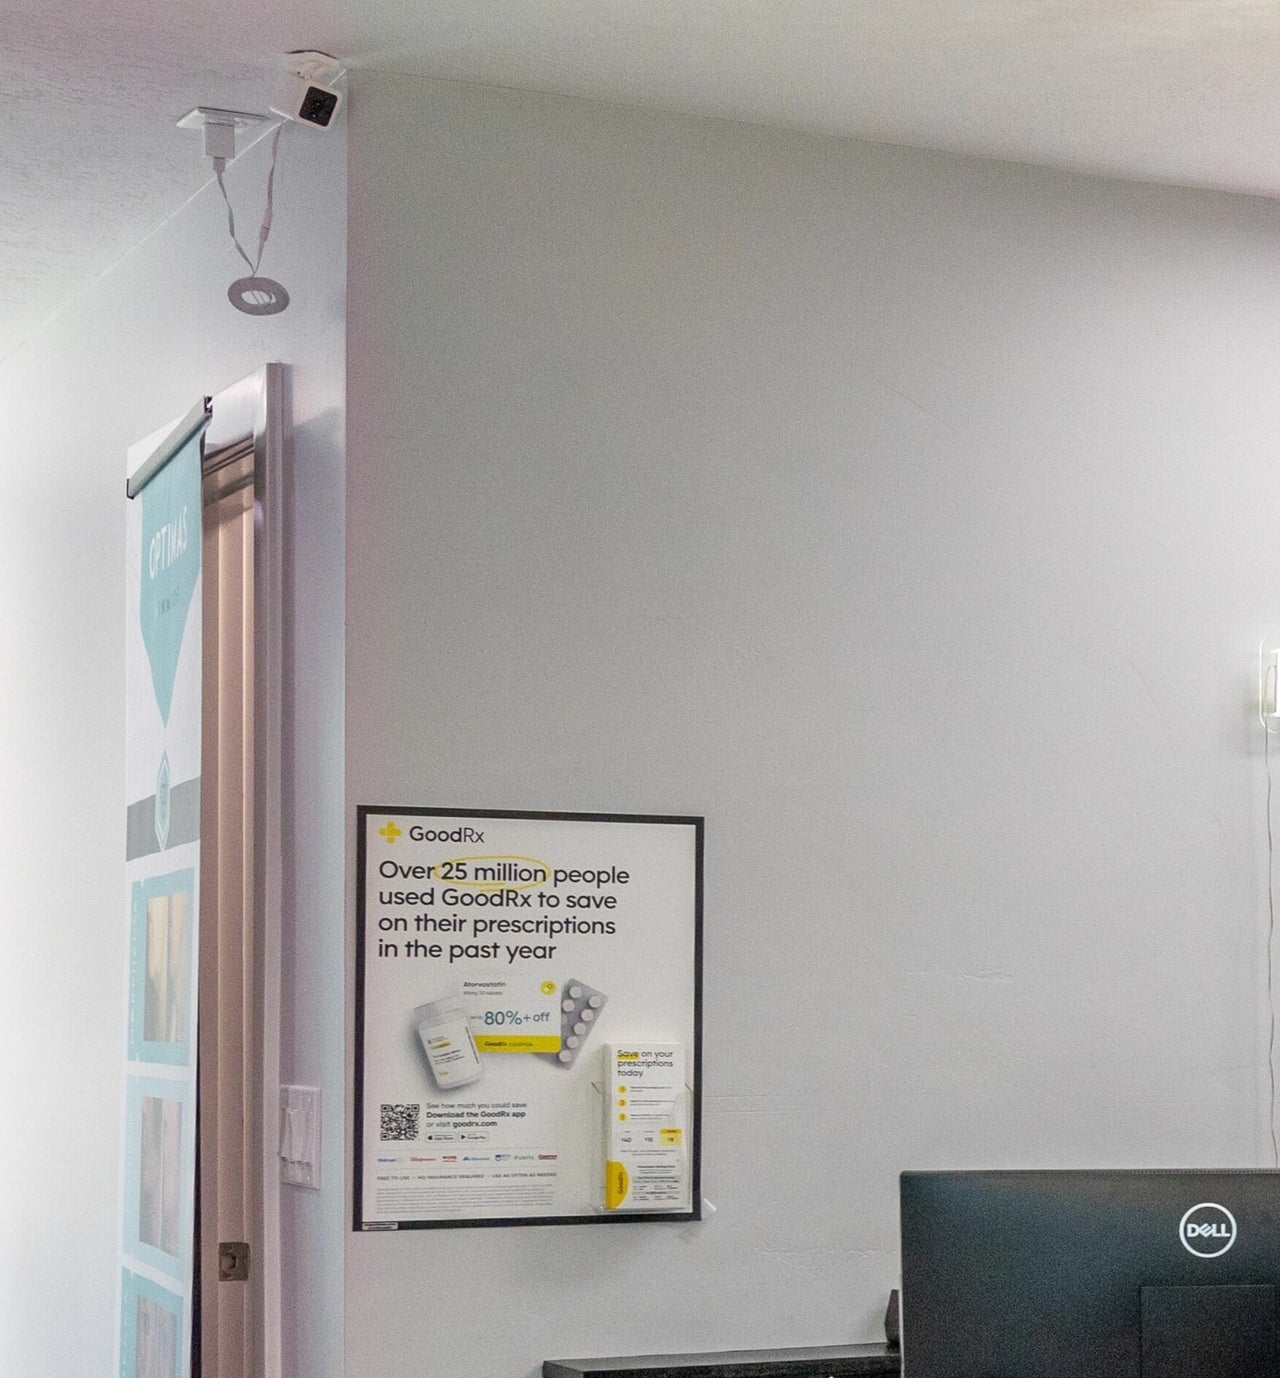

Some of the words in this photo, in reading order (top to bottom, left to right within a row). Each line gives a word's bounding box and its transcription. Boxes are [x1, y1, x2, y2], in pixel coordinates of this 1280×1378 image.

[409, 825, 485, 843] GoodRx
[379, 861, 435, 879] Over
[441, 862, 467, 880] 25
[475, 863, 546, 882] million
[553, 866, 630, 888] people
[379, 887, 434, 905] used
[442, 888, 532, 908] GoodRx
[538, 892, 560, 908] to
[566, 895, 617, 909] save
[379, 917, 407, 932] on
[414, 913, 467, 933] their
[473, 916, 616, 938] prescriptions
[379, 939, 398, 957] in
[405, 940, 442, 958] the
[449, 941, 500, 963] past
[506, 945, 557, 964] year
[533, 1012, 550, 1022] off
[654, 1051, 673, 1059] your
[617, 1060, 674, 1068] prescriptions
[617, 1070, 644, 1078] today
[1186, 1223, 1231, 1238] DELL
